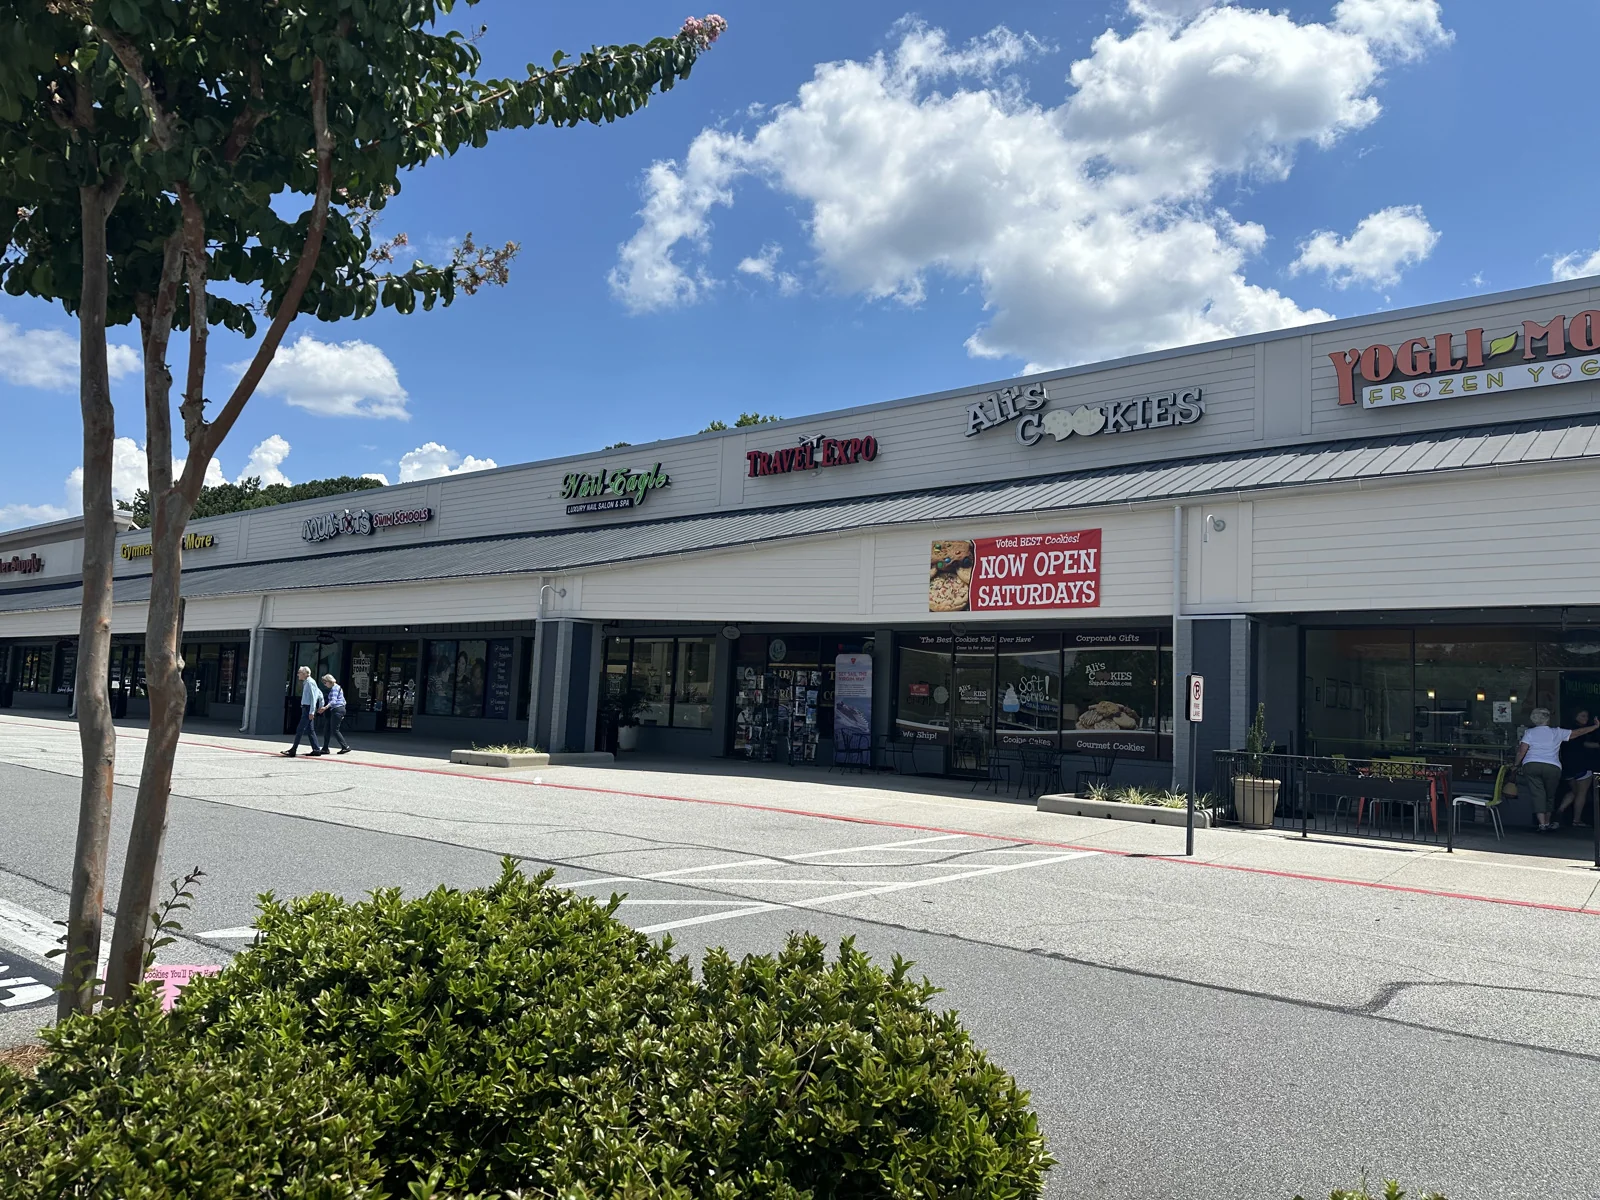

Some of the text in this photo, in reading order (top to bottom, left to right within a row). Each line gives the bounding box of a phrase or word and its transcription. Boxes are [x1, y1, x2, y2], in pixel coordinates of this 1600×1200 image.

[1368, 371, 1504, 405] FROZEN
[964, 382, 1046, 437] Ali's
[747, 435, 878, 477] TRAVEL EXPO
[560, 462, 669, 505] Nail Eagle
[567, 504, 586, 514] LUXURY
[587, 503, 598, 511] NAIL
[598, 501, 614, 510] SALON
[620, 499, 630, 507] SPA
[373, 513, 394, 527] SWIM
[394, 508, 429, 525] SCHOOLS
[186, 533, 212, 550] More
[996, 533, 1080, 548] Voted BEST Cookies!
[11, 553, 42, 574] Supply
[979, 548, 1098, 579] NOW OPEN
[977, 580, 1096, 607] SATURDAYS
[936, 636, 952, 644] Best
[955, 635, 979, 644] Cookies
[1076, 634, 1140, 644] Corporate Gifts
[1085, 662, 1106, 674] Ali's
[1018, 675, 1044, 692] Soft
[916, 731, 937, 741] Ship!
[1076, 740, 1145, 752] Gourmet Cookies
[170, 969, 187, 978] You'll
